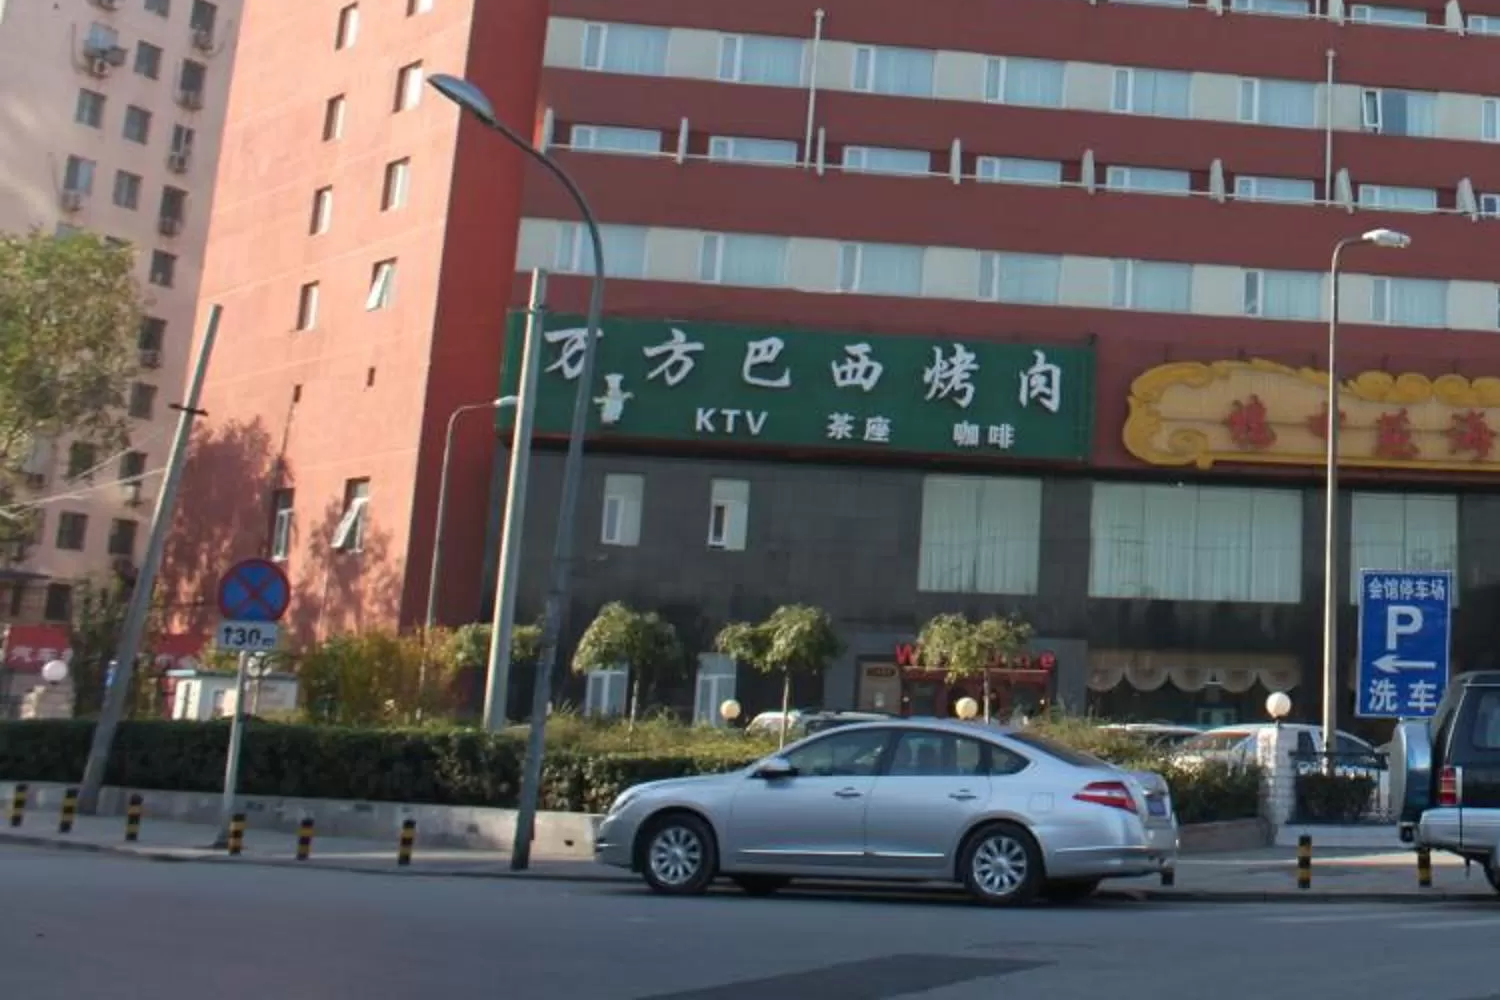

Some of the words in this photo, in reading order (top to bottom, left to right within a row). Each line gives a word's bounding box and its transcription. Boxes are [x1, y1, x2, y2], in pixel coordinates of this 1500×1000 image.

[543, 326, 1062, 414] 万方巴西烤肉
[695, 407, 769, 436] KTV
[826, 412, 892, 443] 茶座
[952, 421, 1016, 449] 咖啡
[1368, 577, 1446, 601] 会馆停车场
[1386, 605, 1424, 650] P
[1368, 677, 1437, 713] 洗车
